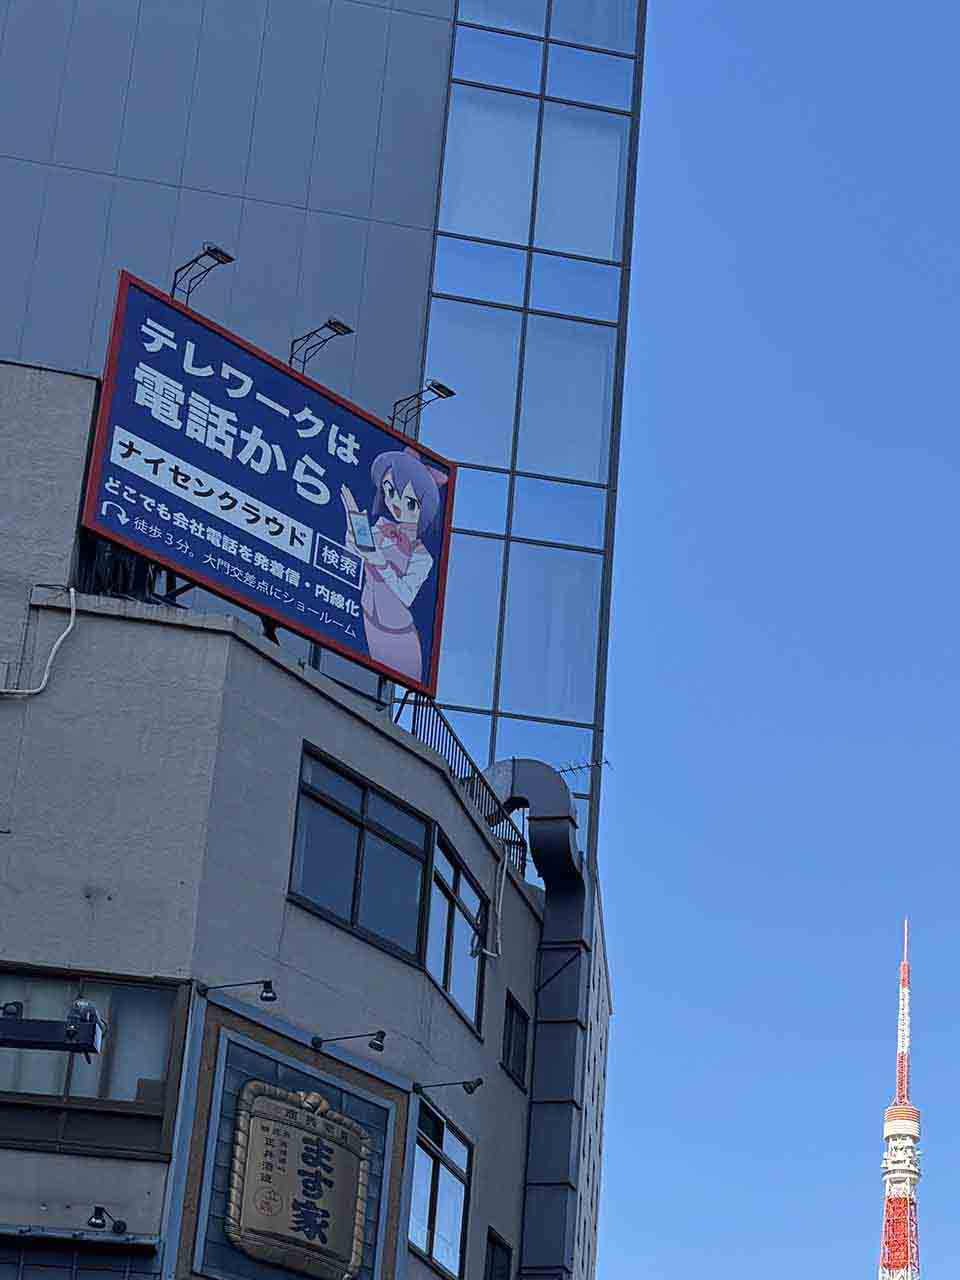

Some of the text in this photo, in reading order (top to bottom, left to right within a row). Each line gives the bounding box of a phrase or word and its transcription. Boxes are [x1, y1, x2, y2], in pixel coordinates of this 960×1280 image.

[132, 361, 331, 506] 電話から
[141, 316, 361, 466] テレワークは
[103, 475, 361, 618] どこでも会社電話を発着信・内線化
[117, 439, 308, 549] ナイセンクラウド
[320, 543, 359, 578] 検索
